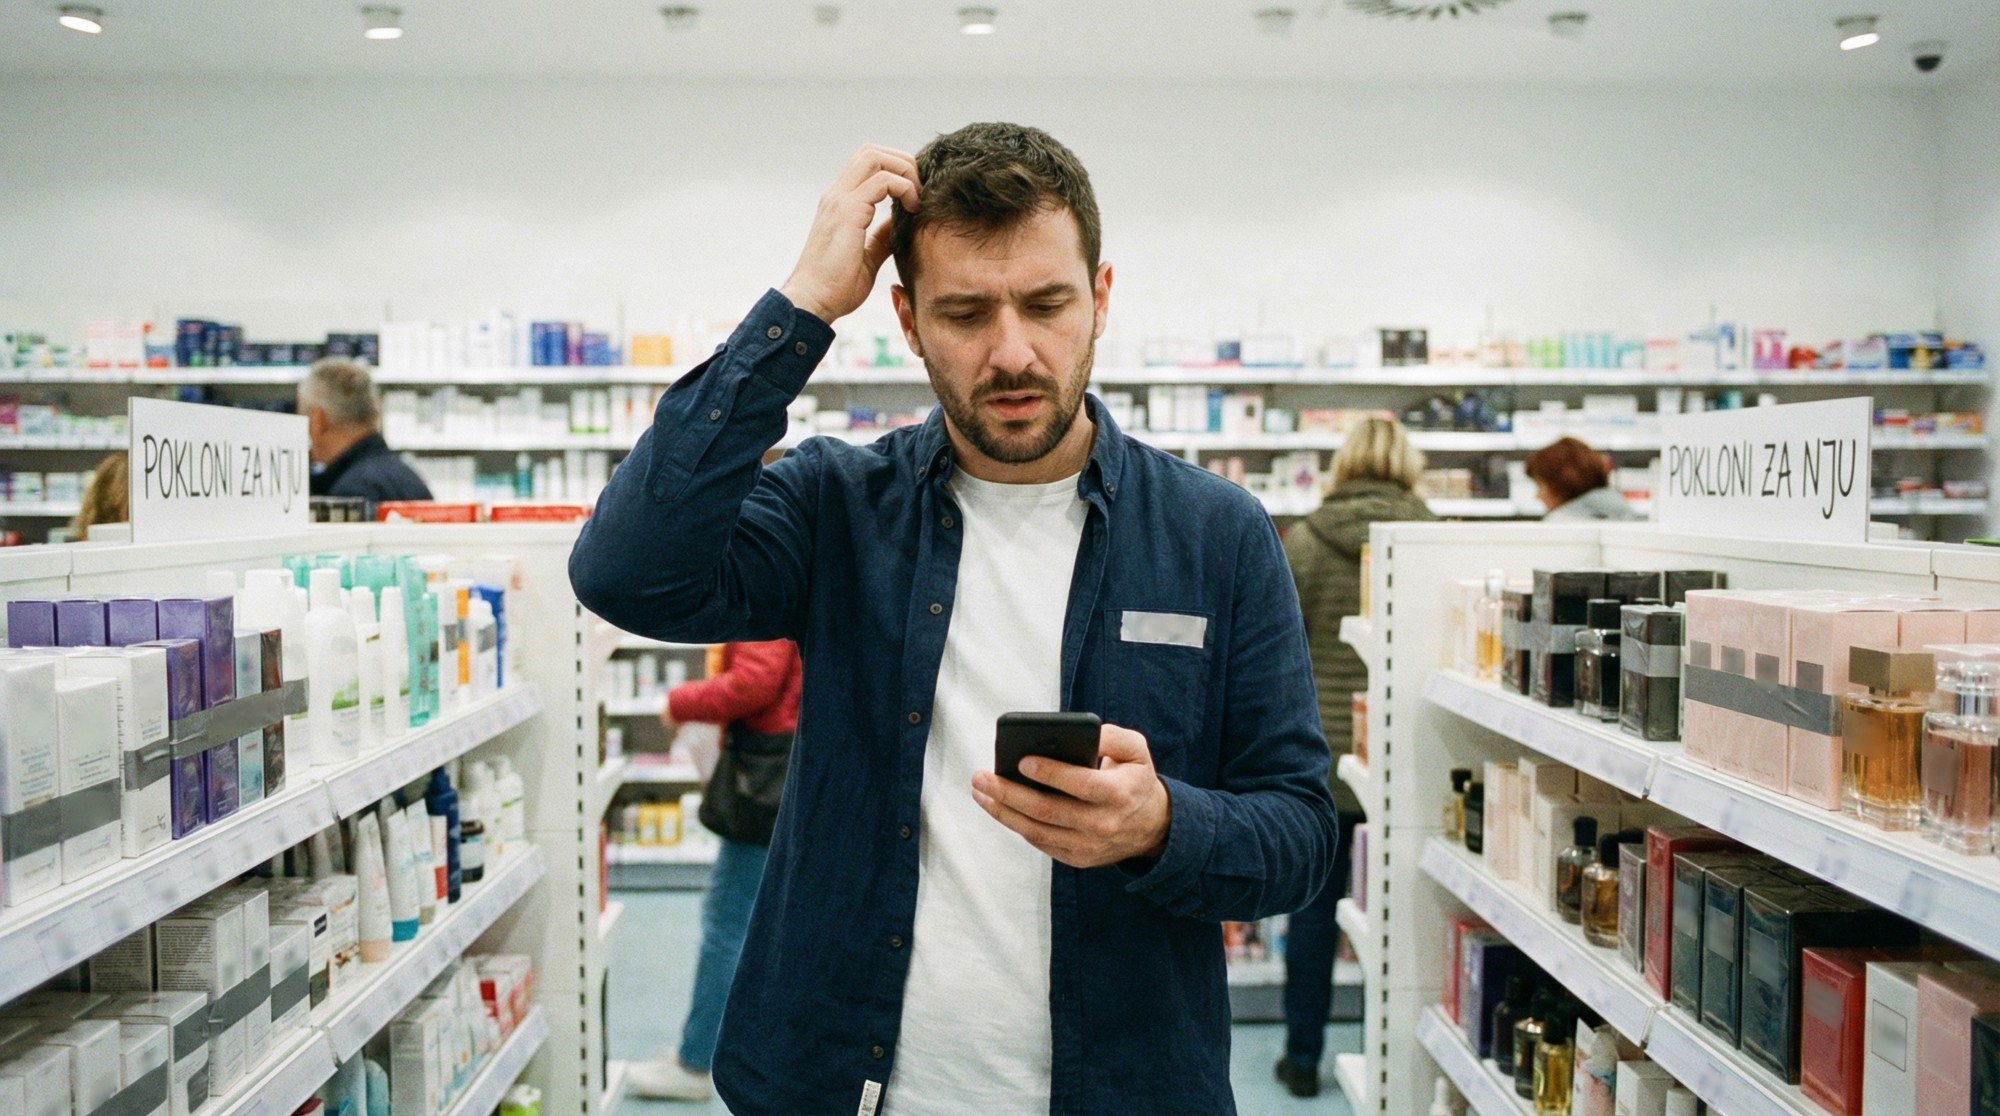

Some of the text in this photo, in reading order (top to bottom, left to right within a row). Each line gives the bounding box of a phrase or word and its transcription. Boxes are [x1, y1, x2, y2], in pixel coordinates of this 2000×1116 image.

[143, 434, 301, 514] POKLONI ZA NJU
[1669, 437, 1856, 519] POKLONI ZA NJU
